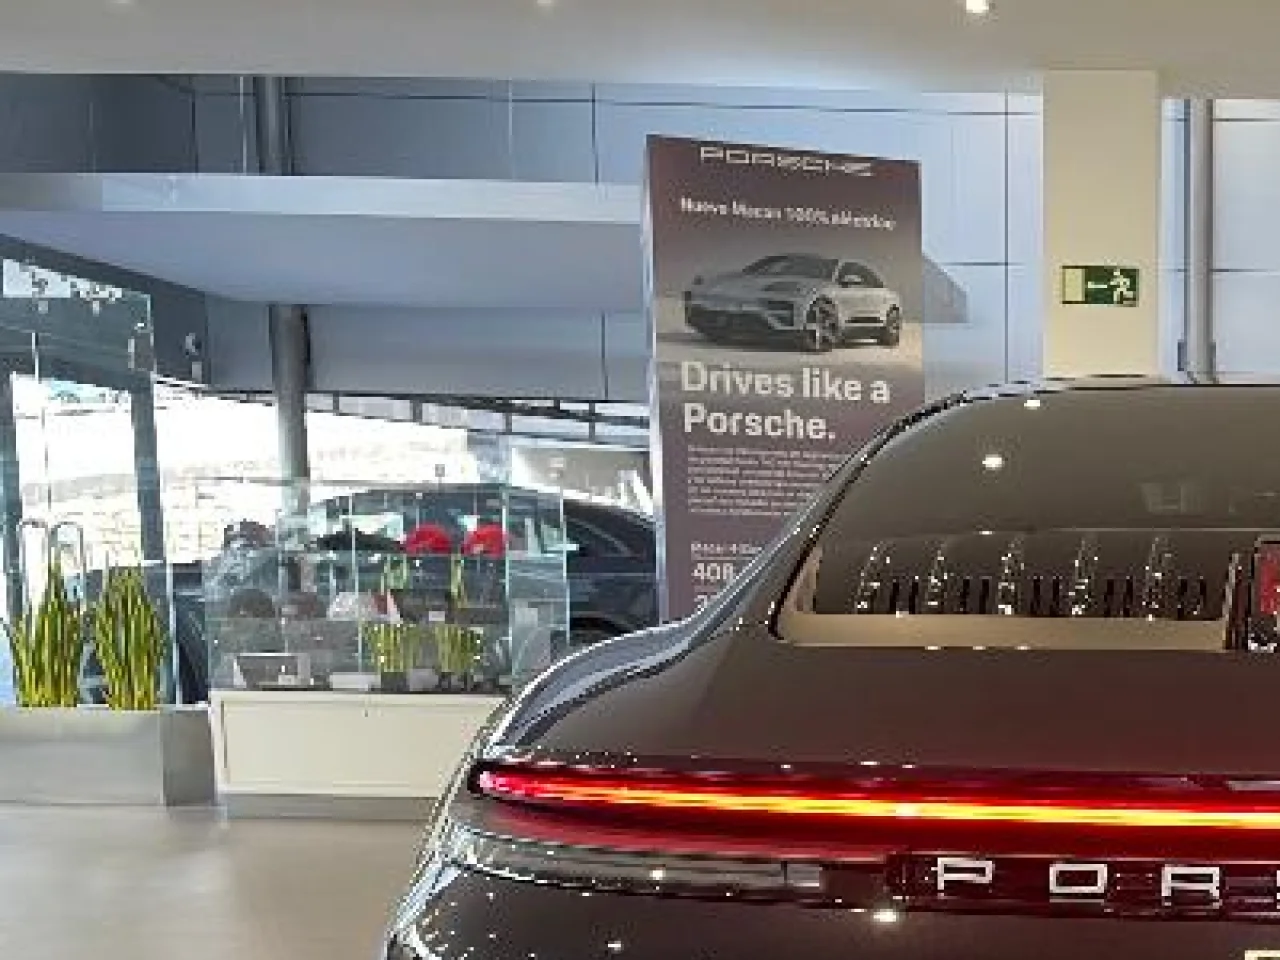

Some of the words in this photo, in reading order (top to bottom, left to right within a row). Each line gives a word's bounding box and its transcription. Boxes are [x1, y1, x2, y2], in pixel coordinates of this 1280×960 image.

[701, 147, 873, 177] PORSCHE
[682, 361, 795, 397] Drives
[803, 367, 862, 401] like
[870, 380, 890, 403] a
[684, 402, 836, 440] Porsche.
